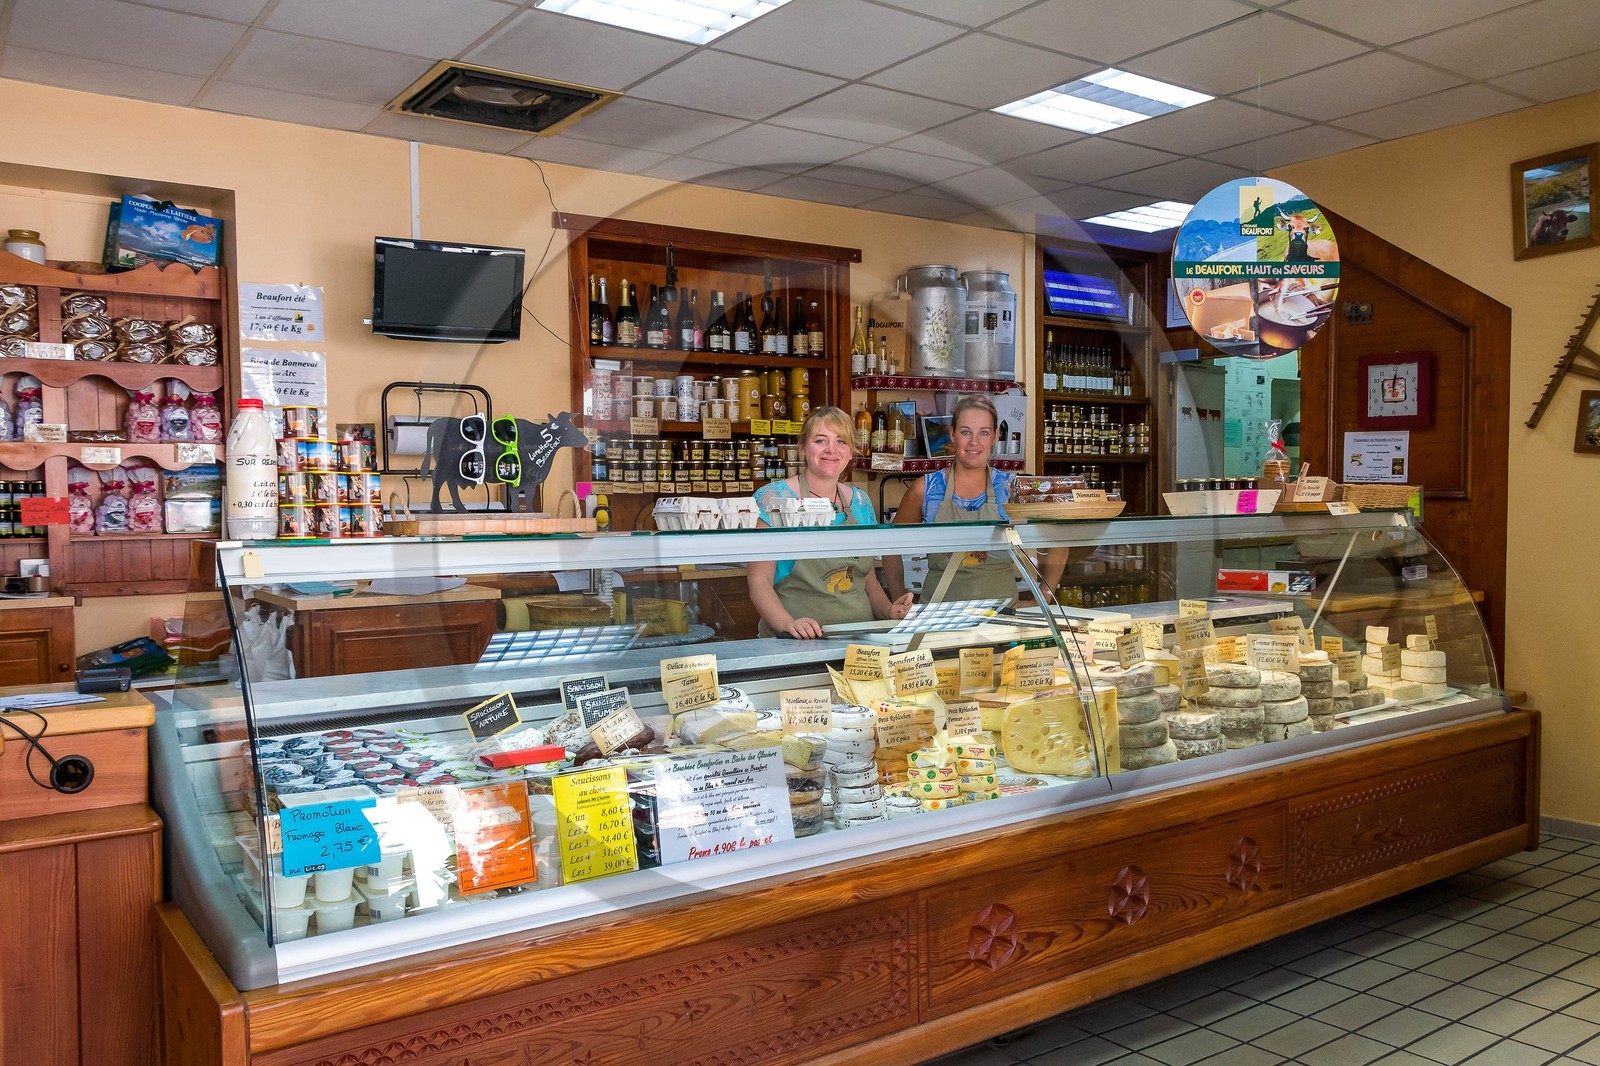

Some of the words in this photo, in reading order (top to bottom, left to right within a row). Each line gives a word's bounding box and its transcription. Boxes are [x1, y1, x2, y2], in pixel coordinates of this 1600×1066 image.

[1241, 227, 1273, 235] BEAUFORT
[1186, 267, 1193, 275] LE
[1195, 264, 1245, 275] BEAUFORT.
[1246, 264, 1272, 275] HAUT
[1283, 264, 1325, 275] SAVEURS
[256, 292, 293, 303] Beaufort
[293, 294, 306, 303] été
[249, 322, 272, 332] 17,50
[274, 323, 281, 332] €
[281, 324, 289, 333] le
[290, 325, 302, 335] Kg
[875, 321, 905, 329] BEAUFORT
[281, 359, 318, 368] Bonneval
[281, 369, 297, 377] Arc
[283, 387, 290, 396] €
[290, 387, 297, 396] le
[298, 388, 310, 397] Kg
[539, 428, 554, 444] 5
[527, 441, 551, 461] Lunettes
[855, 648, 881, 657] Beaufort
[666, 661, 684, 671] Délice
[887, 655, 916, 668] Beaufort
[916, 653, 926, 662] été
[914, 660, 934, 670] Fermier
[1016, 661, 1039, 670] Emmental
[567, 680, 604, 693] SAUCISSON
[681, 675, 700, 687] Tamié
[915, 680, 920, 688] €
[919, 679, 925, 687] le
[924, 678, 933, 687] Kg
[1039, 677, 1044, 685] le
[1045, 677, 1053, 686] Kg
[584, 696, 627, 710] SAUCISSON
[675, 697, 693, 709] 16,40
[700, 692, 706, 702] le
[785, 696, 809, 705] Moelleux
[470, 699, 505, 722] SAUCISSON
[958, 706, 978, 714] Reblochon
[807, 715, 813, 724] €
[813, 714, 819, 724] le
[878, 715, 889, 724] Petit
[889, 712, 911, 722] Reblochon
[899, 735, 911, 743] pièce
[747, 752, 756, 761] des
[756, 750, 777, 763] Glaciers
[749, 763, 768, 774] Beaufort
[570, 772, 612, 787] Saucissons
[704, 782, 714, 791] Bleu
[745, 775, 754, 783] Arc
[289, 805, 352, 823] Promotion
[566, 813, 586, 824] L'un
[600, 806, 618, 818] 8,60
[619, 805, 625, 814] €
[284, 828, 325, 843] Fromage
[334, 821, 365, 834] Blanc
[567, 827, 582, 838] Les
[583, 825, 589, 834] 2
[598, 819, 620, 832] 16,70
[621, 817, 627, 827] €
[568, 841, 582, 851] Les
[584, 839, 589, 848] 3
[600, 832, 622, 845] 24,40
[623, 830, 629, 840] €
[320, 841, 354, 860] 2,75
[357, 834, 370, 846] €
[688, 846, 711, 860] Promo
[569, 855, 584, 866] Les
[585, 852, 591, 861] 4
[601, 845, 623, 858] 31,60
[624, 844, 630, 853] €
[571, 868, 585, 879] Les
[587, 865, 592, 875] 5
[603, 858, 625, 871] 39,00
[626, 857, 632, 866] €
